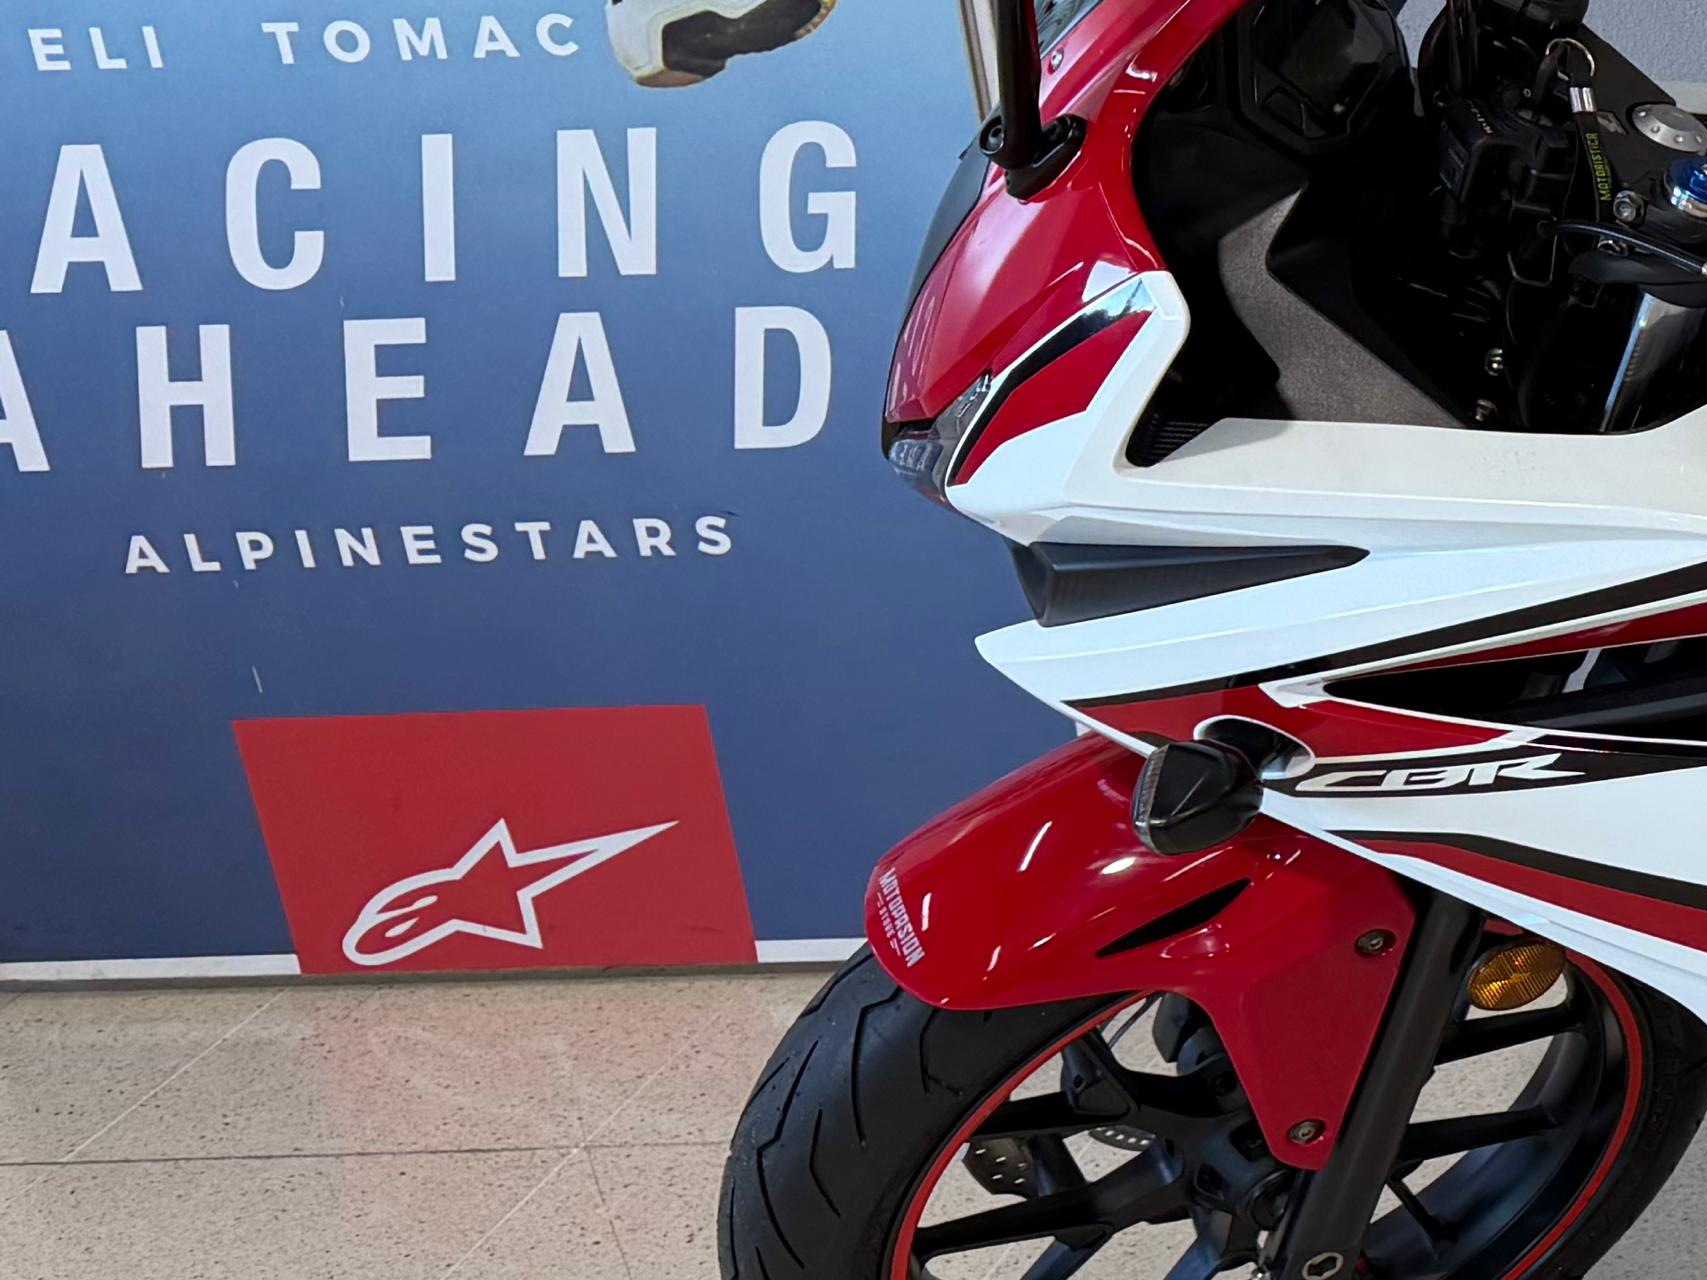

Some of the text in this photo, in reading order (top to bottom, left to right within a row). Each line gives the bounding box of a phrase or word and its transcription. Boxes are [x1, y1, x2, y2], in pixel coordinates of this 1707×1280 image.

[28, 14, 580, 72] ELI TOMAC
[125, 515, 733, 576] ALPINESTARS
[1295, 753, 1588, 792] CBR
[879, 867, 925, 968] MOTOPASION
